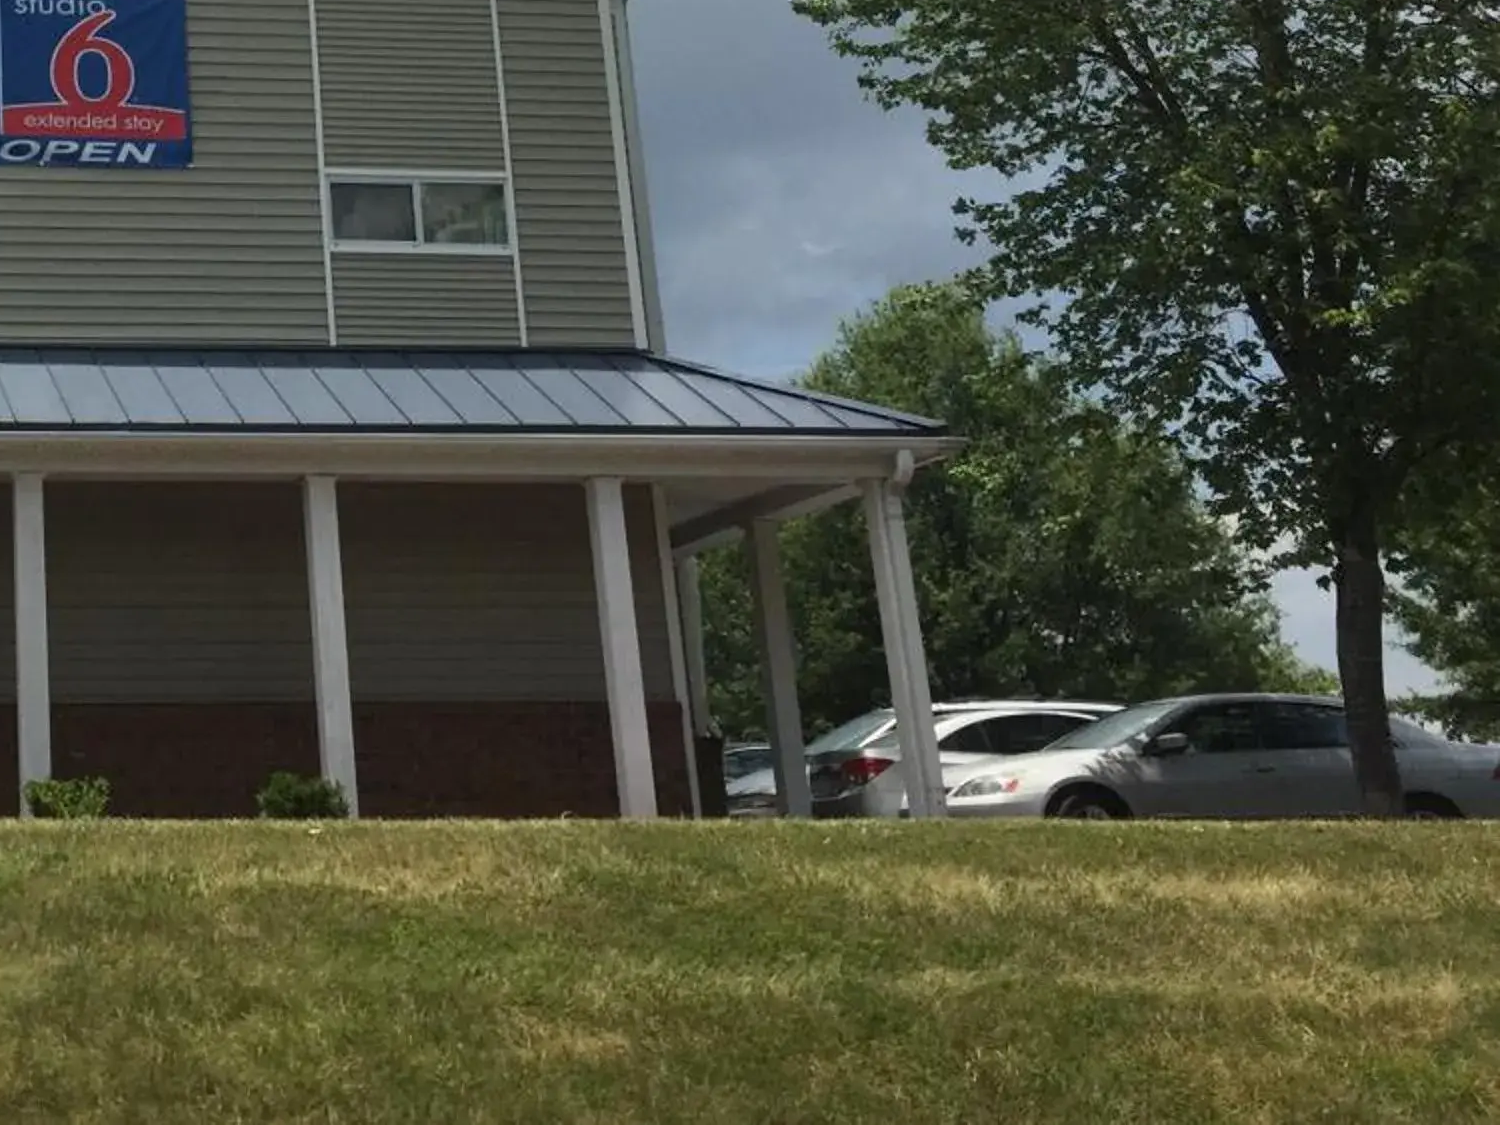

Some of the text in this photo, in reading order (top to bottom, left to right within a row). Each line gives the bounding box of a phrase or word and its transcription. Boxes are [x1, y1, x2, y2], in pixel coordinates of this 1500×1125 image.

[49, 9, 135, 107] 6
[23, 111, 165, 132] extended stay
[0, 139, 157, 164] OPEN
